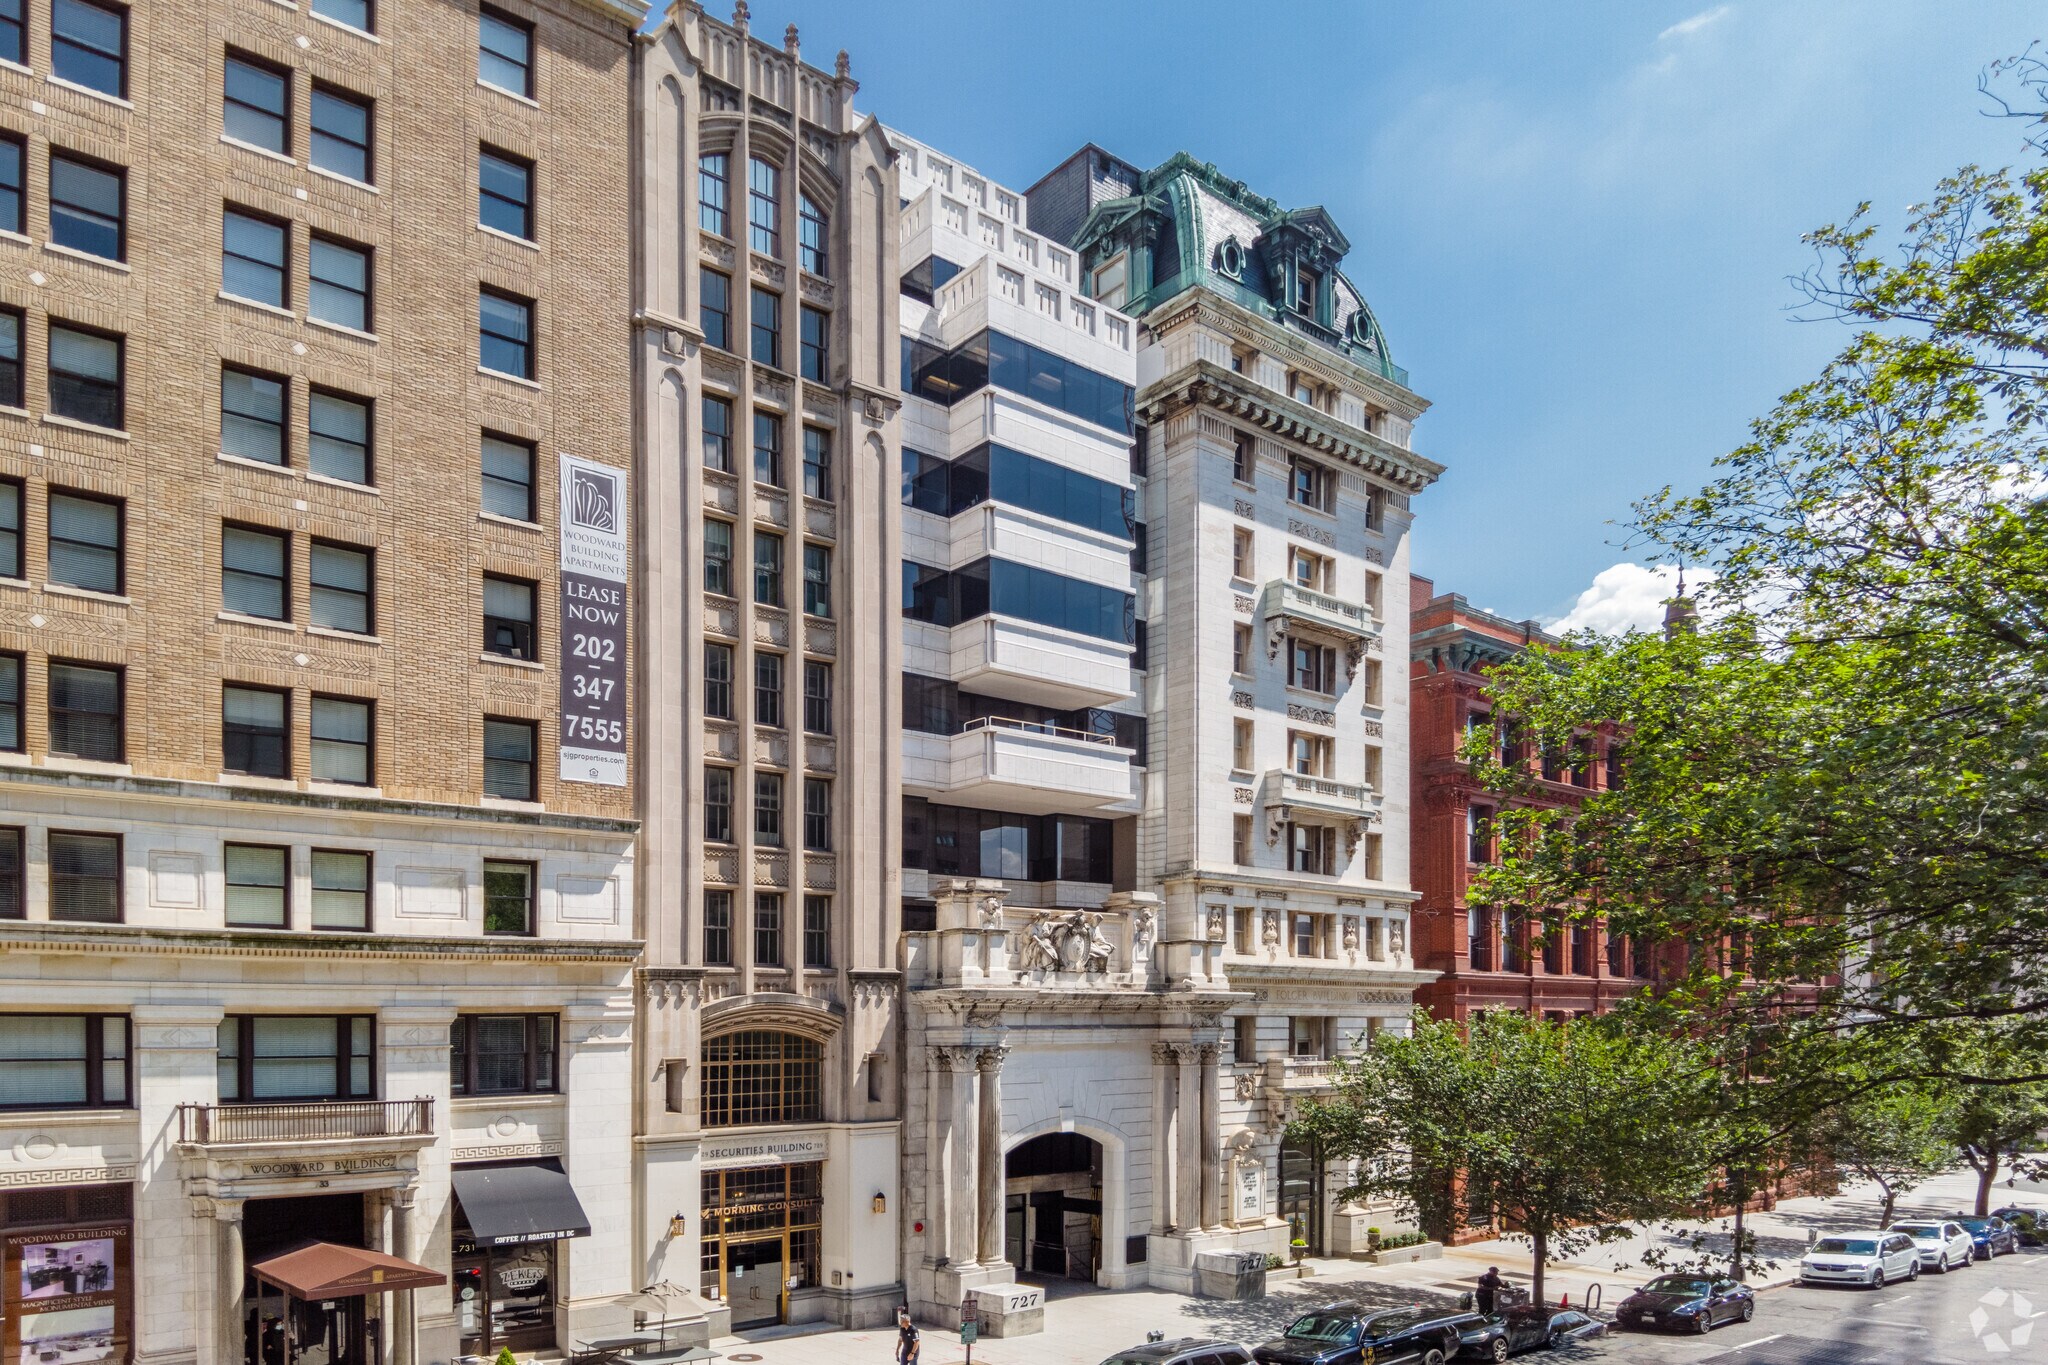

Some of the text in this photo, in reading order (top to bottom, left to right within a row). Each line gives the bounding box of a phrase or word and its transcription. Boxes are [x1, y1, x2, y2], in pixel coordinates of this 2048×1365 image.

[564, 530, 625, 551] WOODWARD
[571, 545, 619, 562] BUILDING
[564, 556, 625, 576] APARTMENTS
[566, 581, 620, 606] LEASE
[568, 603, 619, 626] NOW
[573, 633, 615, 662] 202
[573, 674, 615, 701] 347
[566, 714, 622, 743] 7555
[563, 751, 625, 764] sjgproperties.com
[1276, 989, 1307, 1001] FOLGER
[709, 1145, 764, 1158] SECURITIES
[767, 1142, 813, 1153] BUILDING
[250, 1162, 325, 1174] WOODWARD
[714, 1200, 813, 1217] MORNING CONSULT
[8, 1228, 127, 1245] WOODWARD BUILDING
[494, 1235, 519, 1244] COFFEE
[527, 1232, 556, 1241] ROASTED
[557, 1230, 565, 1238] IN
[459, 1244, 475, 1252] 731
[1240, 1257, 1262, 1271] 727
[21, 1297, 72, 1309] MAGNIFICENT
[40, 1301, 93, 1312] MONUMENTAL
[1010, 1293, 1038, 1310] 727
